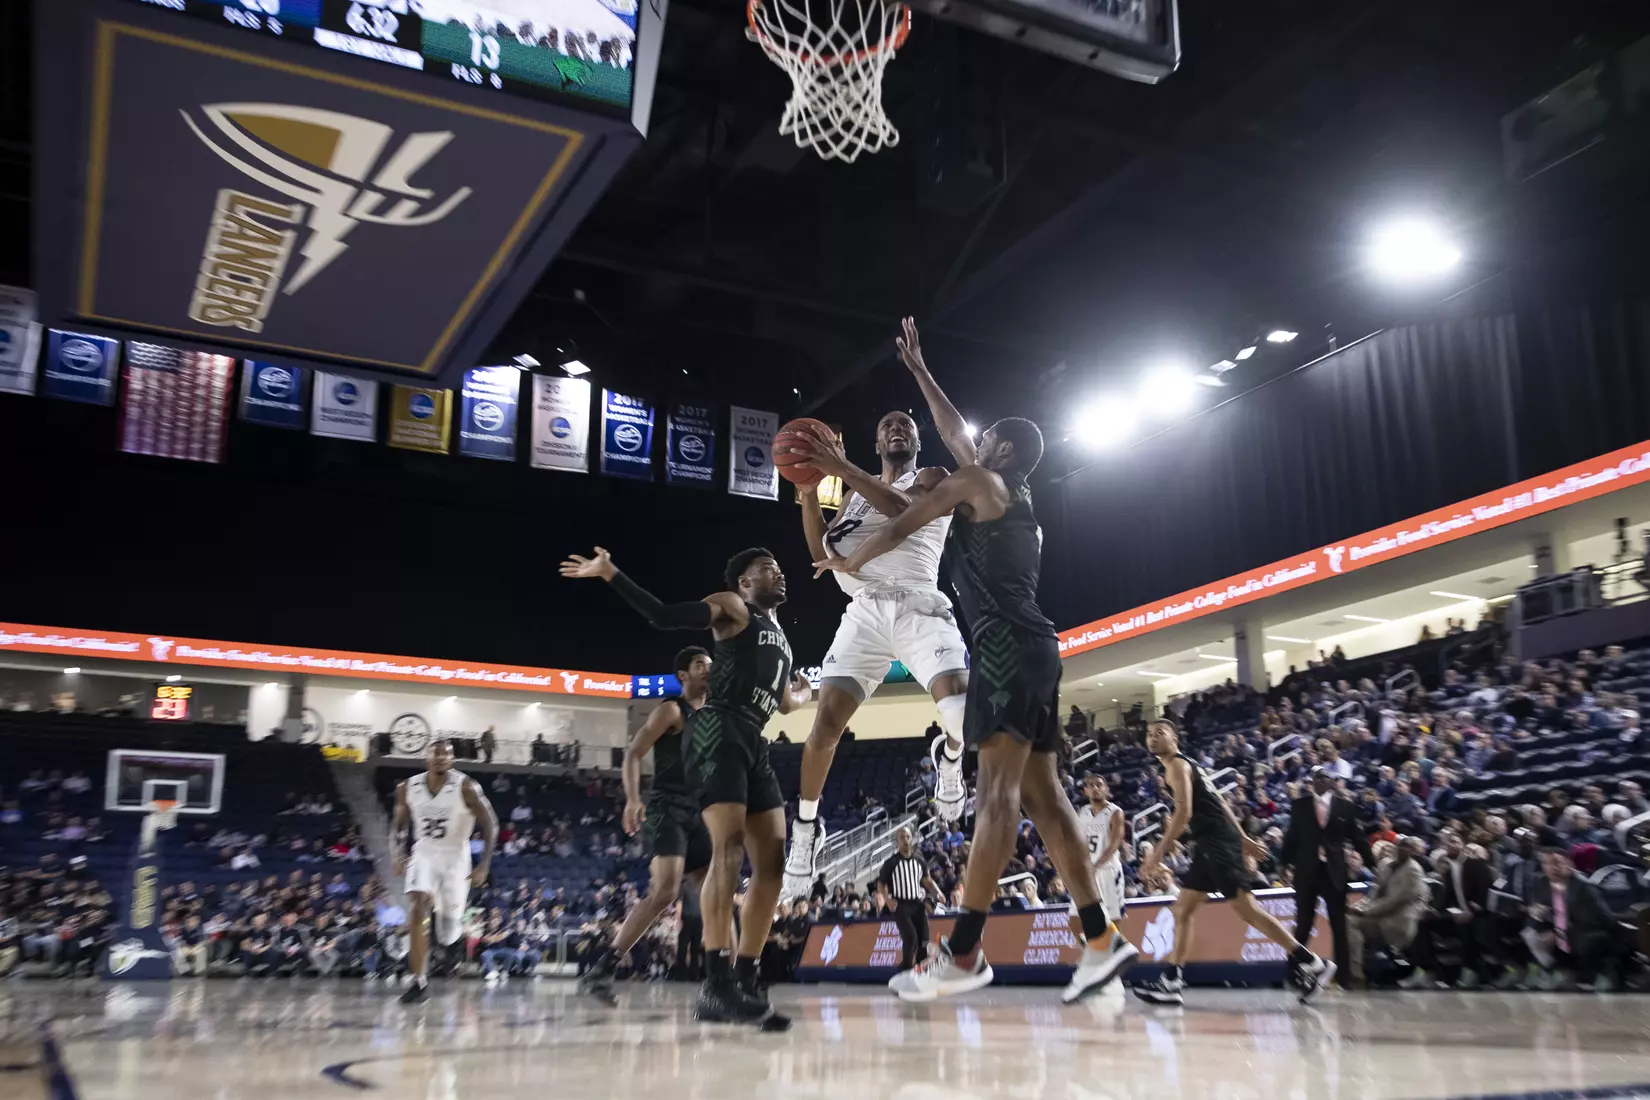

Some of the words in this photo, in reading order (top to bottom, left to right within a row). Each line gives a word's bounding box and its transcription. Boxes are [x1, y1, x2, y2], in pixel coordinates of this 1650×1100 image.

[468, 31, 501, 70] 13
[188, 187, 305, 334] LANCERS
[613, 393, 645, 407] 2017
[679, 404, 708, 417] 2017
[741, 415, 768, 428] 2017
[736, 427, 772, 438] WOMEN'S
[1068, 631, 1087, 648] Food
[1087, 627, 1112, 643] Service
[1112, 618, 1135, 634] Voted
[1146, 611, 1164, 625] Best
[1164, 601, 1194, 618] Private
[1193, 592, 1228, 609] College
[771, 658, 784, 691] 1
[583, 678, 624, 692] Provider
[874, 936, 903, 951] MEDICA
[1023, 948, 1060, 965] CLINIC
